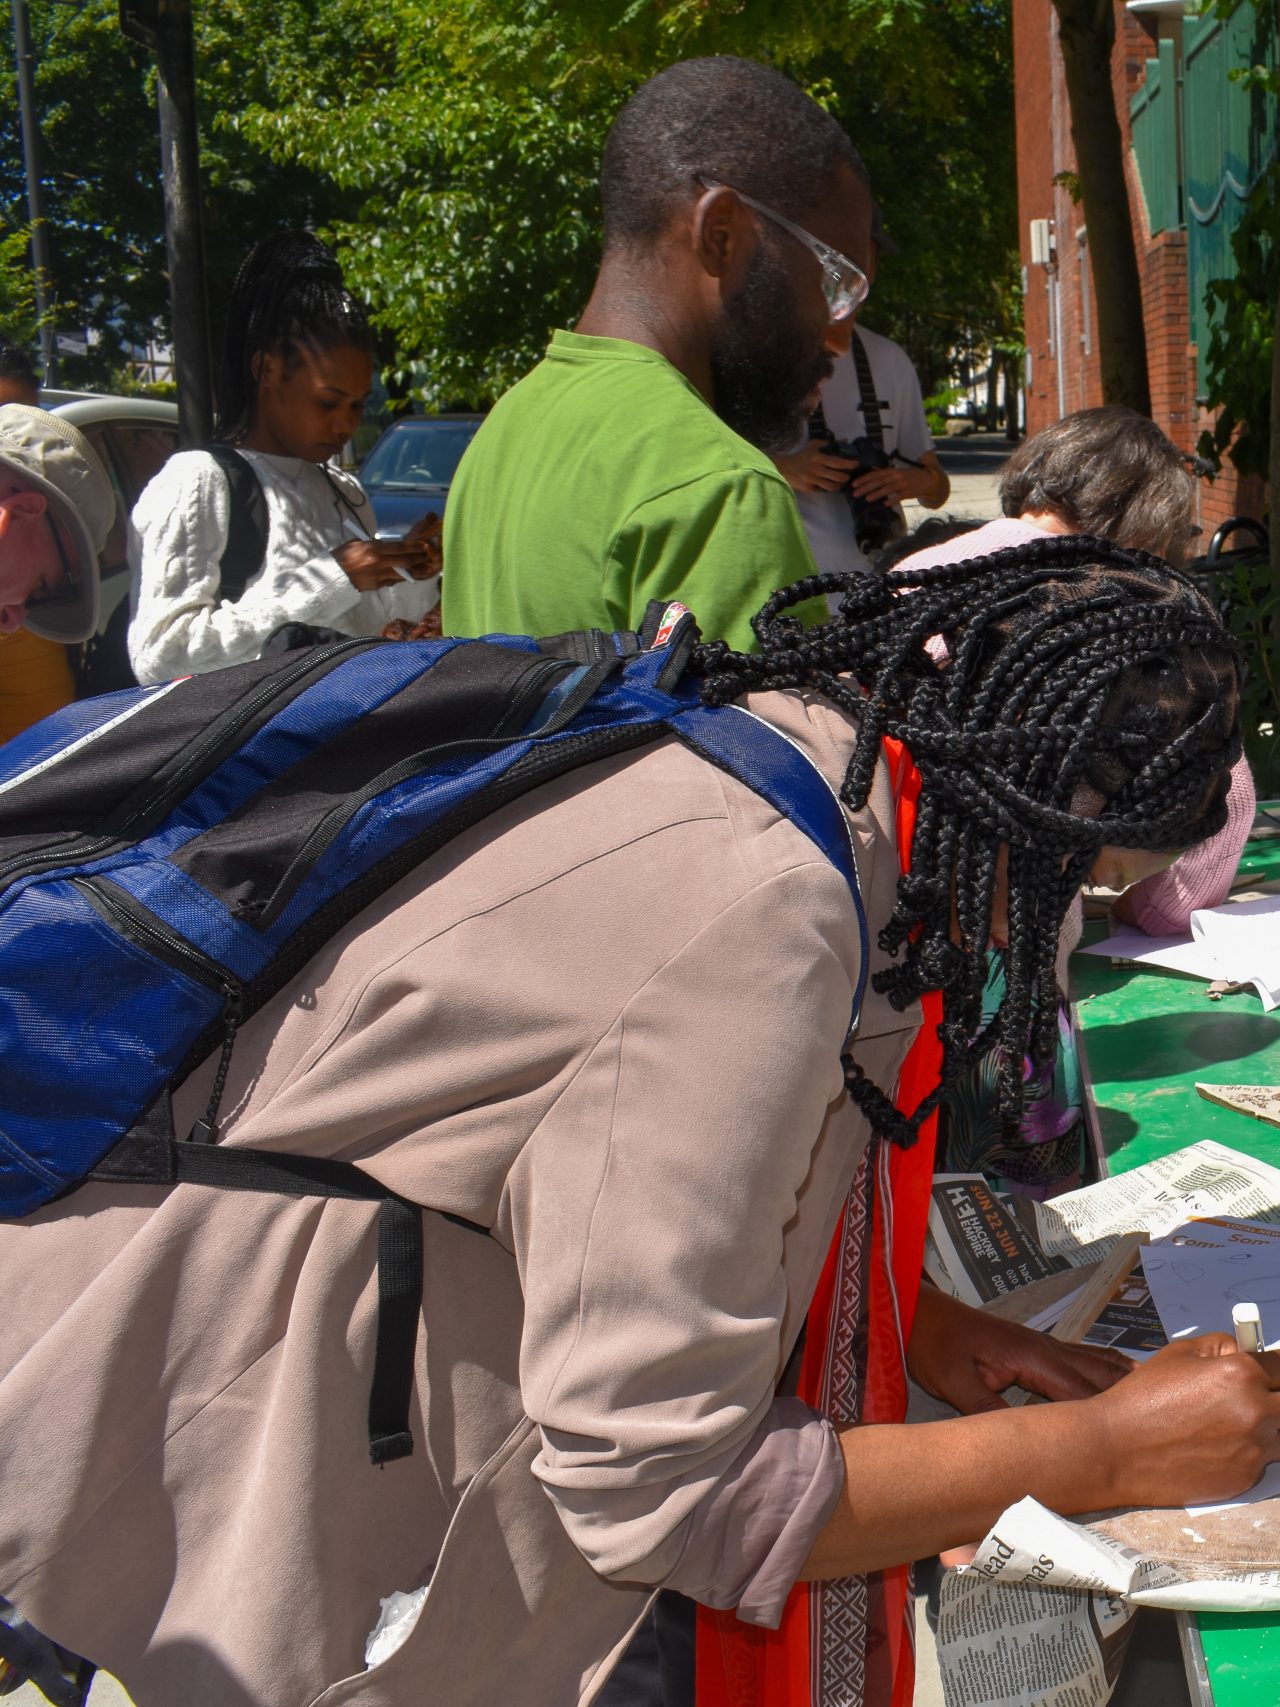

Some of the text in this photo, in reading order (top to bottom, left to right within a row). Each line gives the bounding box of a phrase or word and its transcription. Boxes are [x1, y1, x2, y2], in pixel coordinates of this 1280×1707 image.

[970, 1185, 992, 1211] SUN
[985, 1212, 1002, 1229] 22
[995, 1229, 1020, 1258] JUN
[1225, 1222, 1256, 1234] LOCAL
[960, 1219, 985, 1259] EMPIRE
[970, 1216, 1001, 1263] HACKNEY
[1006, 1269, 1019, 1285] 020
[1018, 1262, 1034, 1283] hac
